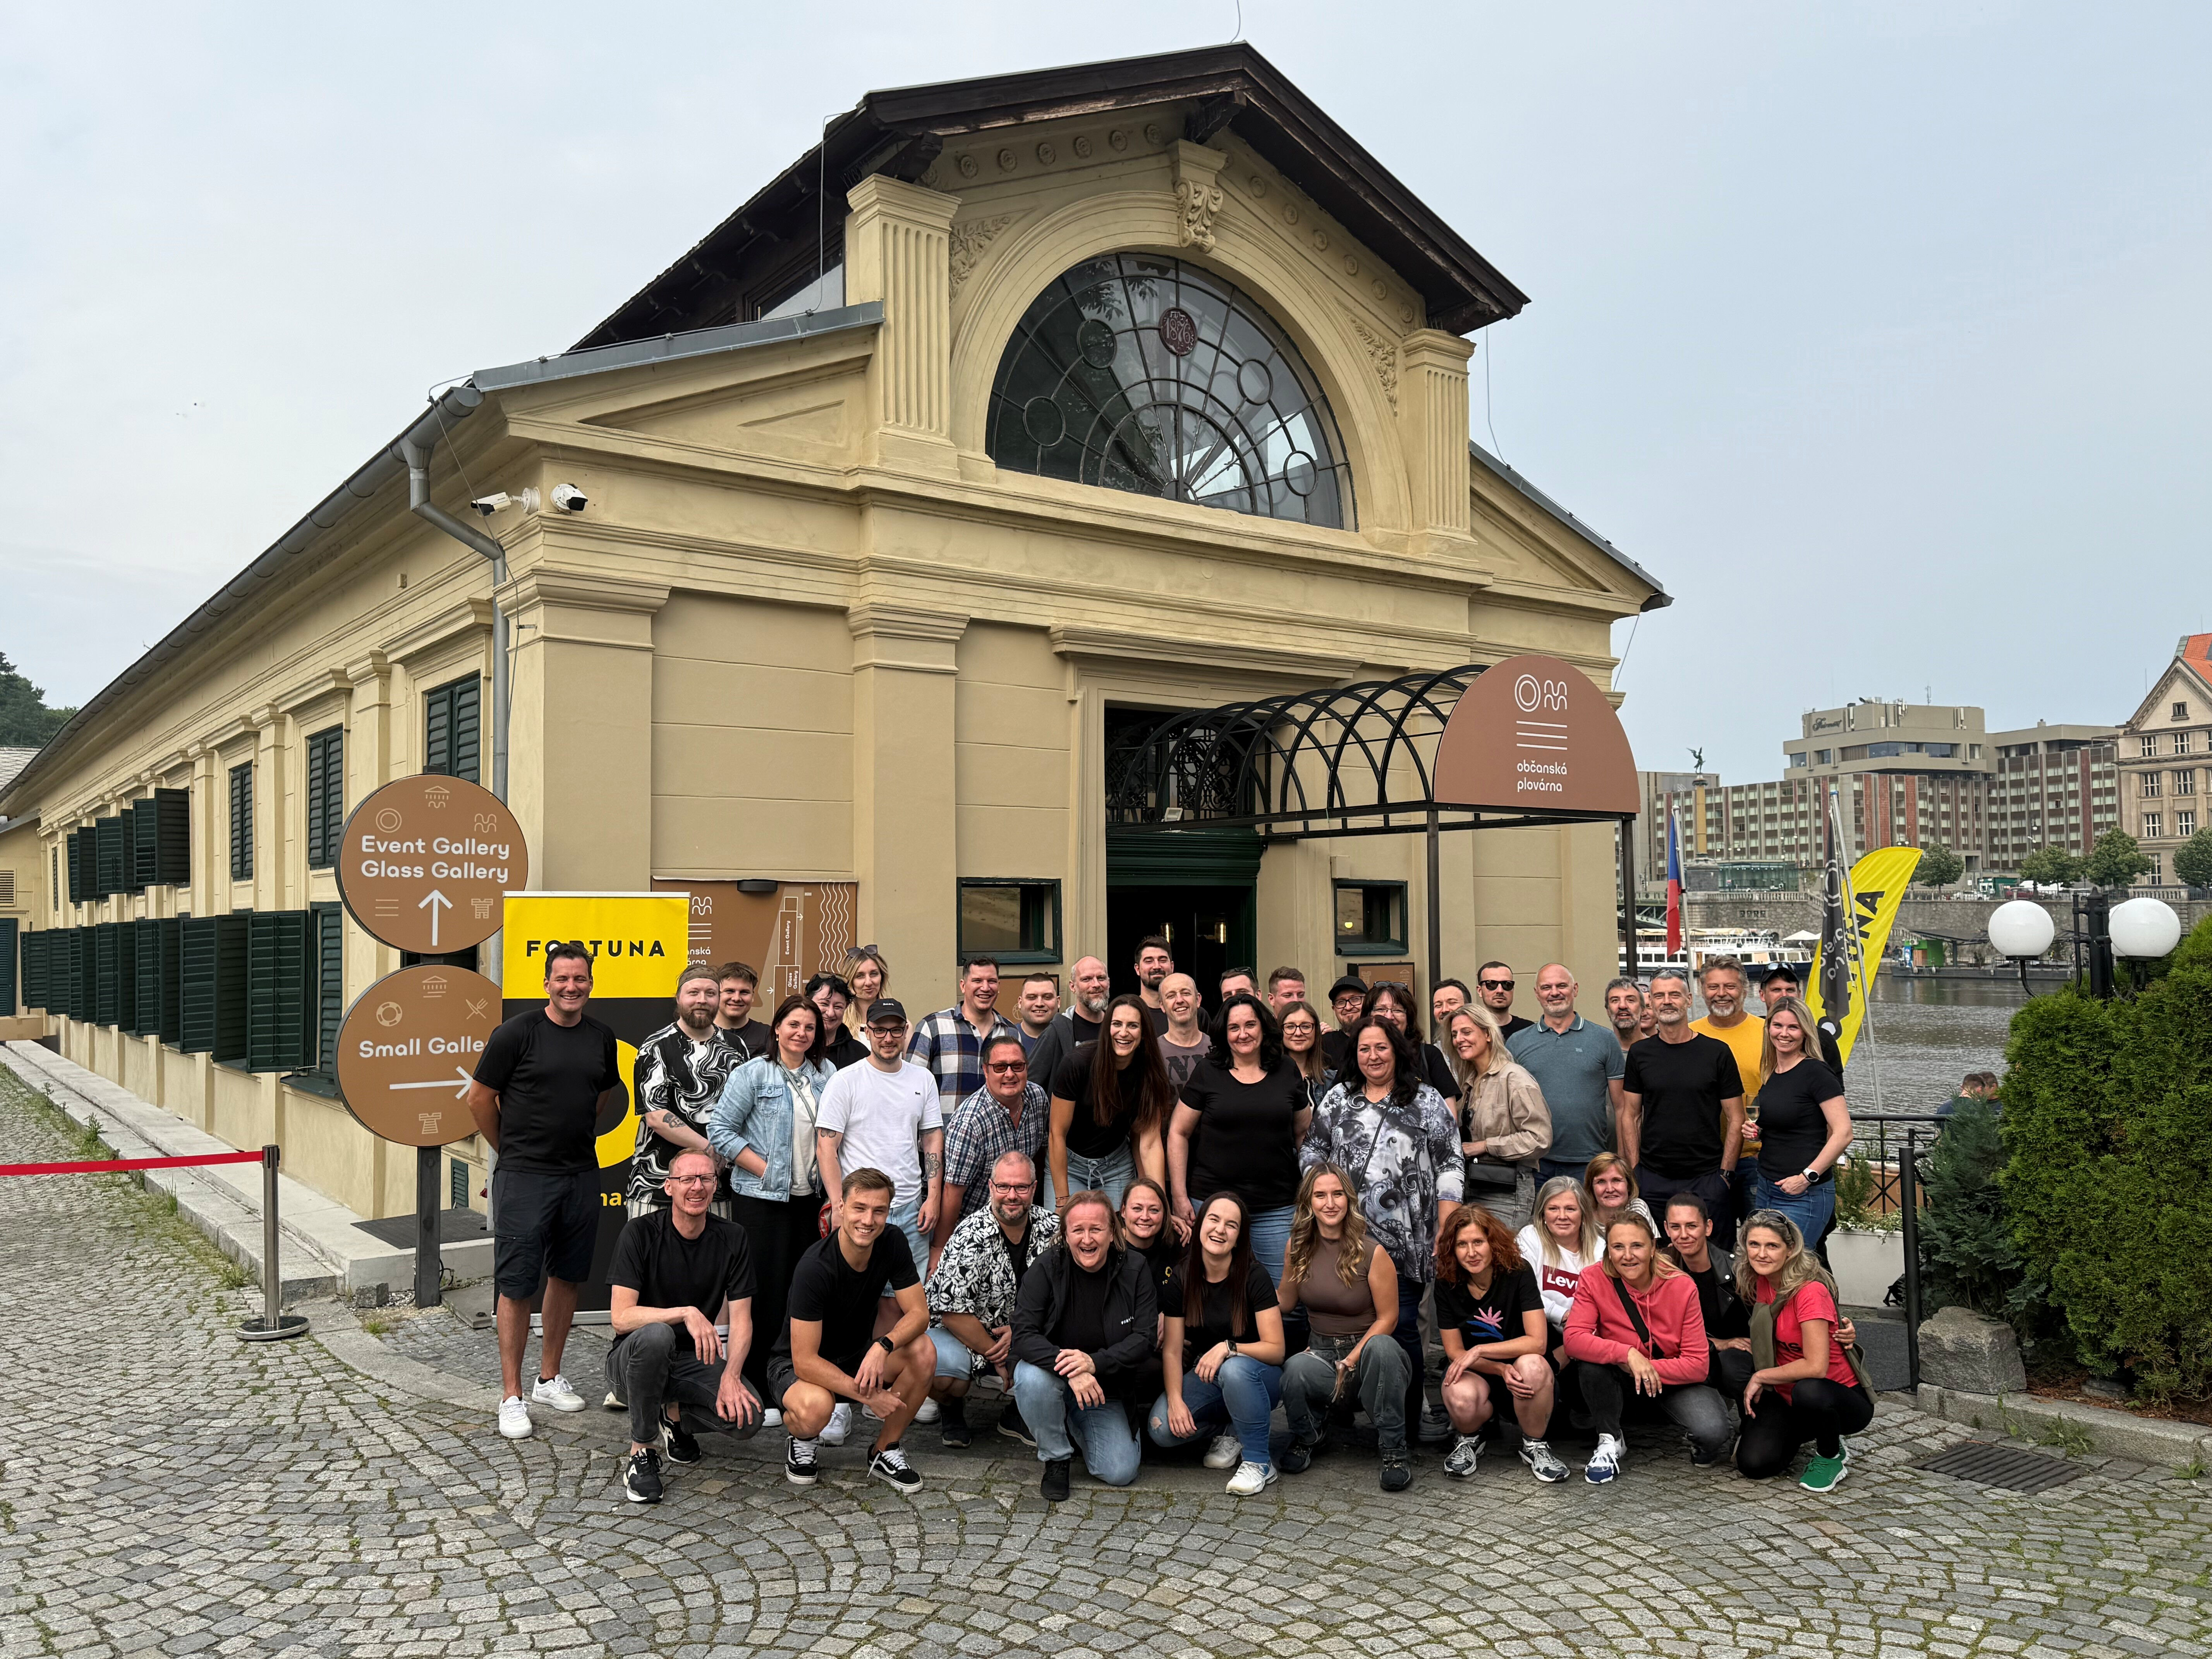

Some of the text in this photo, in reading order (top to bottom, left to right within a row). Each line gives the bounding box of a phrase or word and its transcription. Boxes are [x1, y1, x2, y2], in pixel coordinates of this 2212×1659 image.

[1164, 317, 1190, 344] 1876
[1517, 759, 1567, 775] občanská
[1517, 778, 1563, 792] plovárna
[362, 835, 509, 860] Event Gallery
[361, 860, 508, 883] Glass Gallery
[688, 946, 711, 955] nská
[359, 1036, 488, 1058] Small Galle
